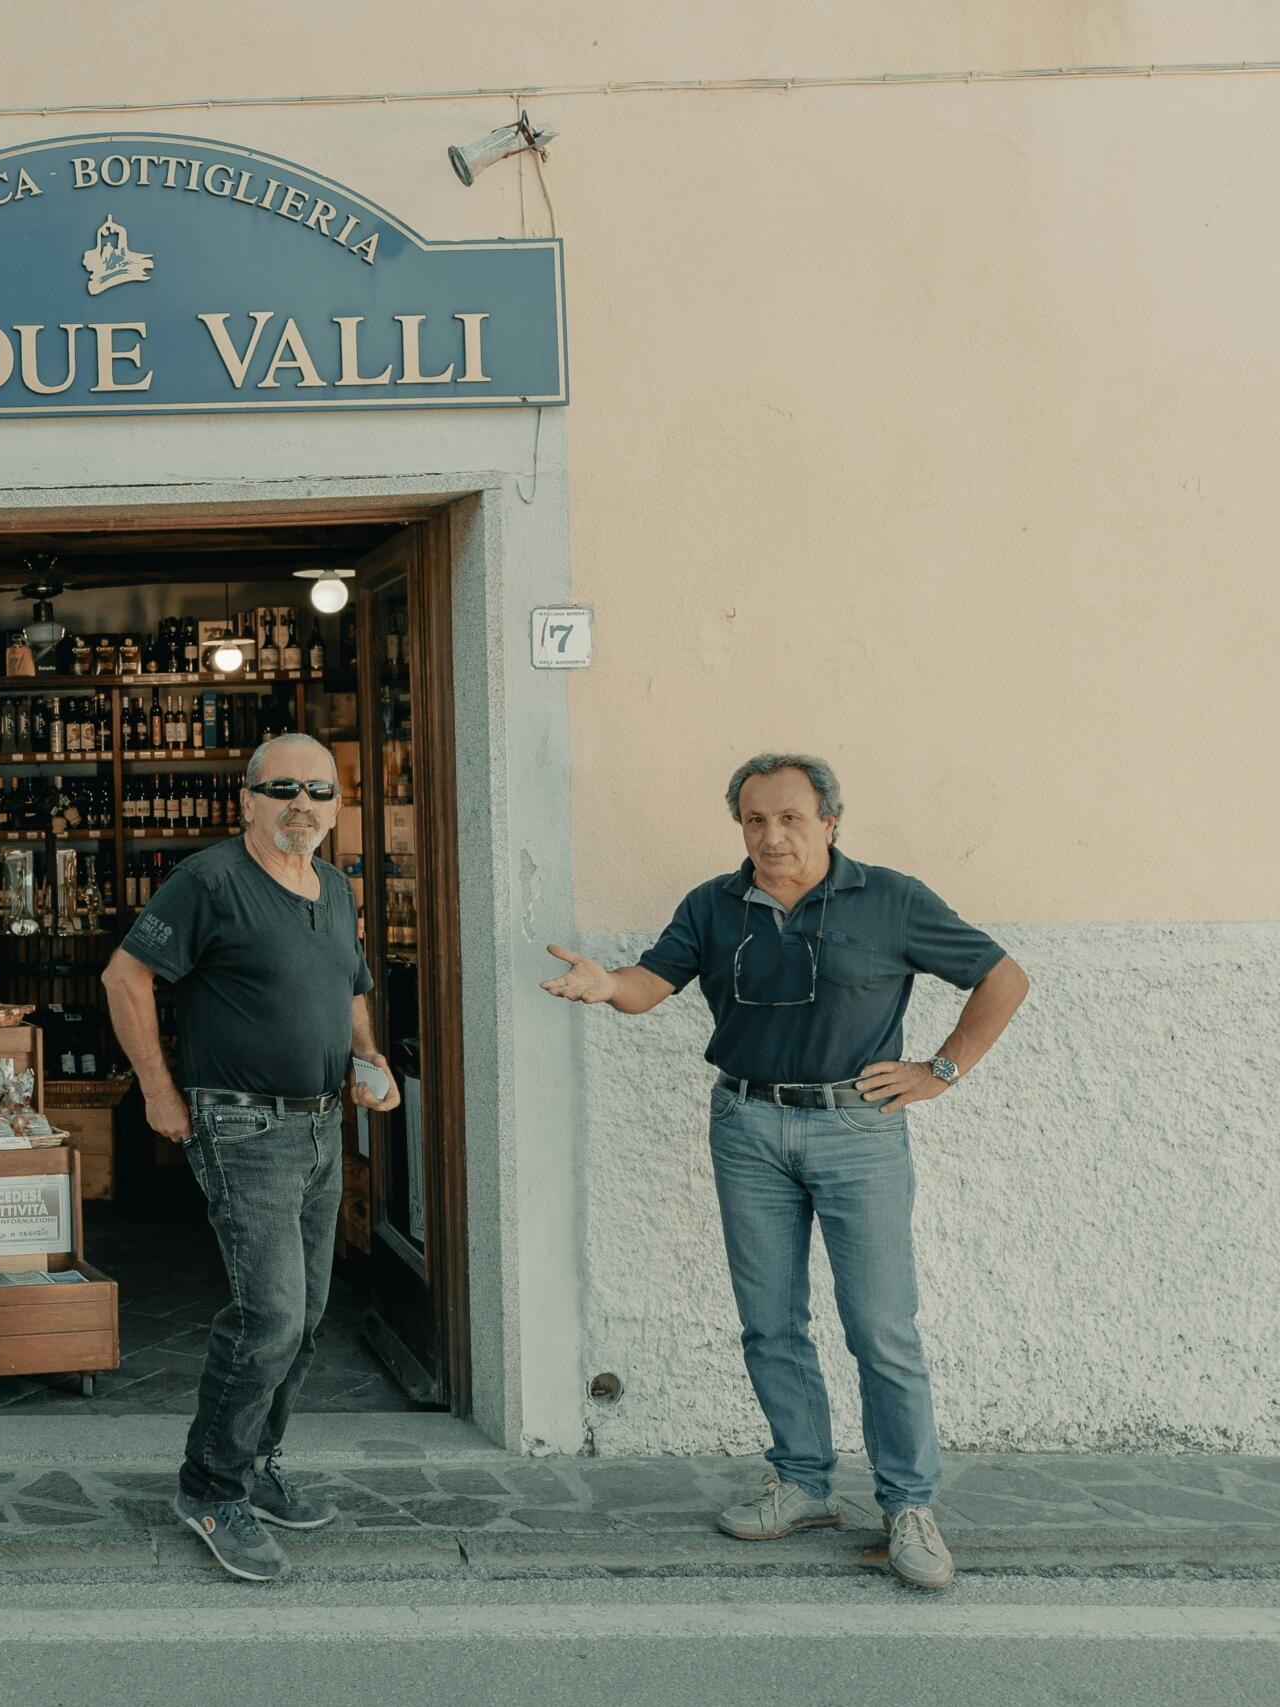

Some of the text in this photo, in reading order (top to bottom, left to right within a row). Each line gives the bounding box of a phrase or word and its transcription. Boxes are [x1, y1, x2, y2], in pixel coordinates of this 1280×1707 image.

[70, 153, 381, 267] BOTTIGLIERIA
[197, 310, 494, 388] VALLI
[549, 624, 575, 654] 7
